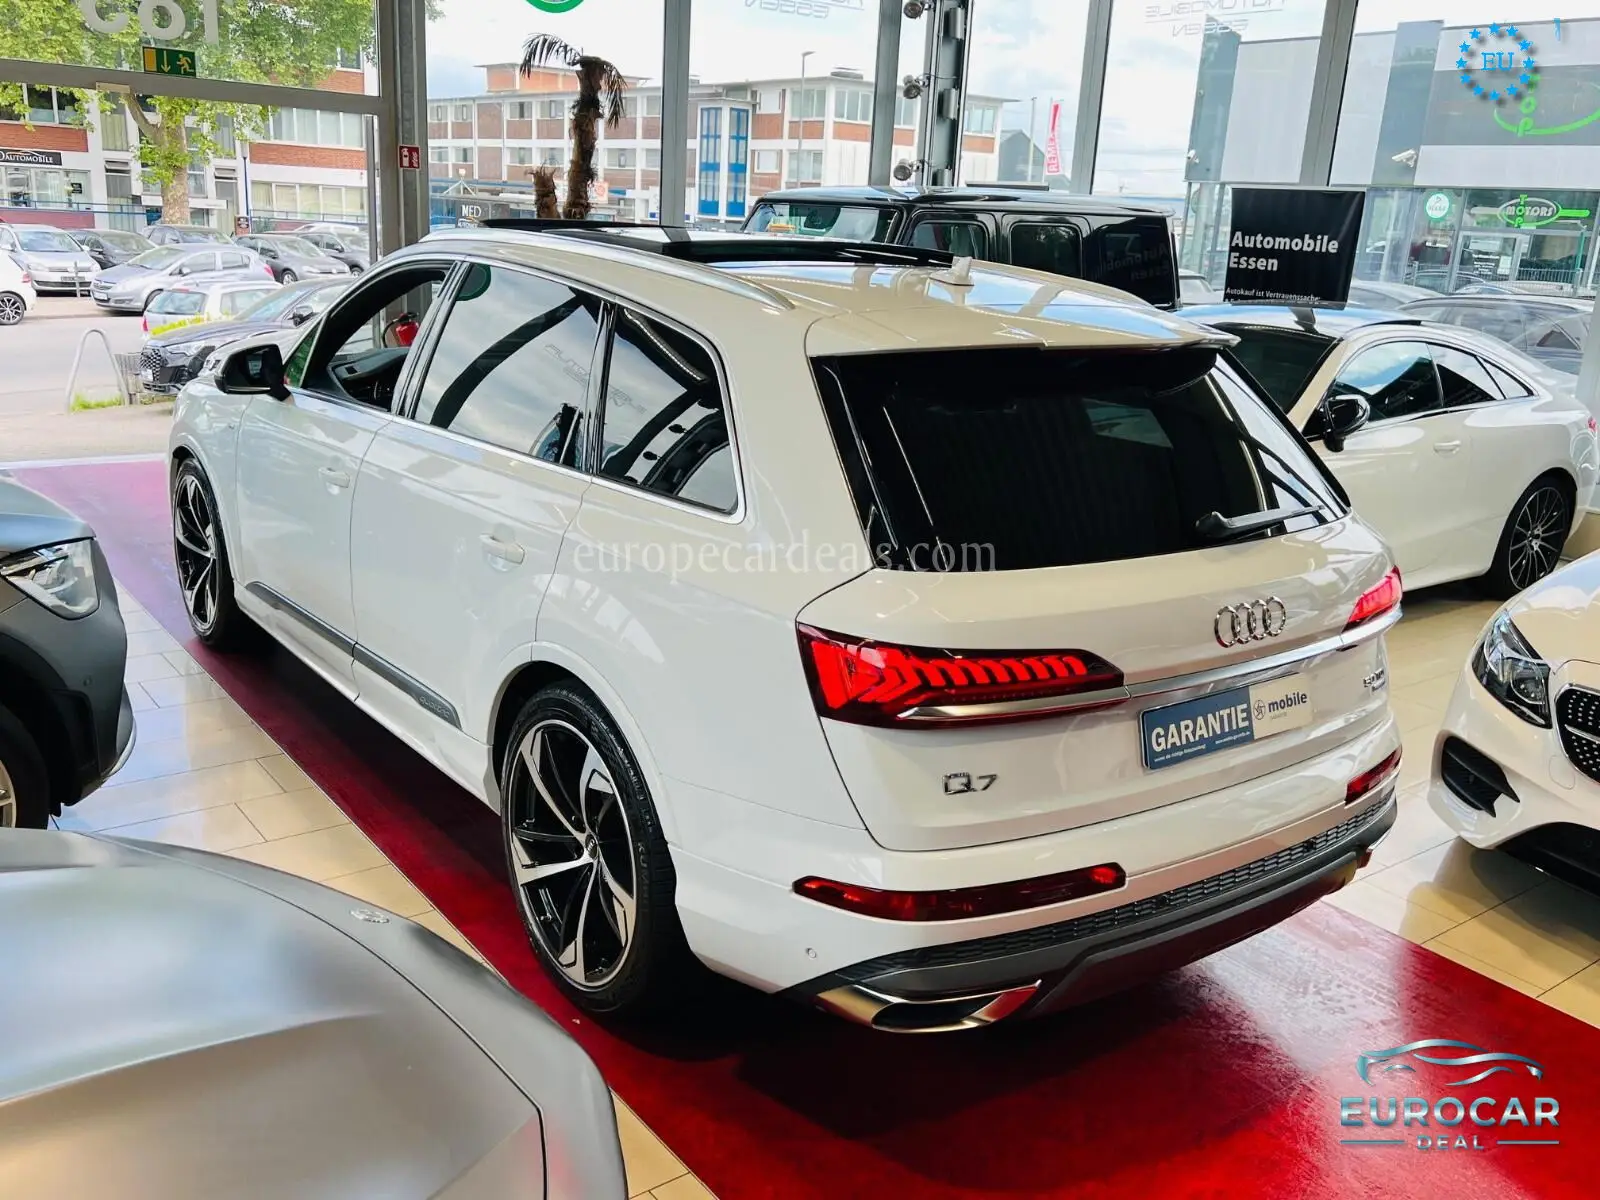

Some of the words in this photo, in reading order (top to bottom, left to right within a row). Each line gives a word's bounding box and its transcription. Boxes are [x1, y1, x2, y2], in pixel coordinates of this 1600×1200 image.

[461, 204, 482, 218] MED
[1231, 231, 1339, 253] Automobile
[1229, 252, 1278, 271] Essen
[1225, 287, 1254, 296] Autokauf
[1255, 289, 1264, 297] ist
[1268, 691, 1308, 713] mobile
[1151, 703, 1250, 752] GARANTIE
[944, 772, 998, 795] Q7
